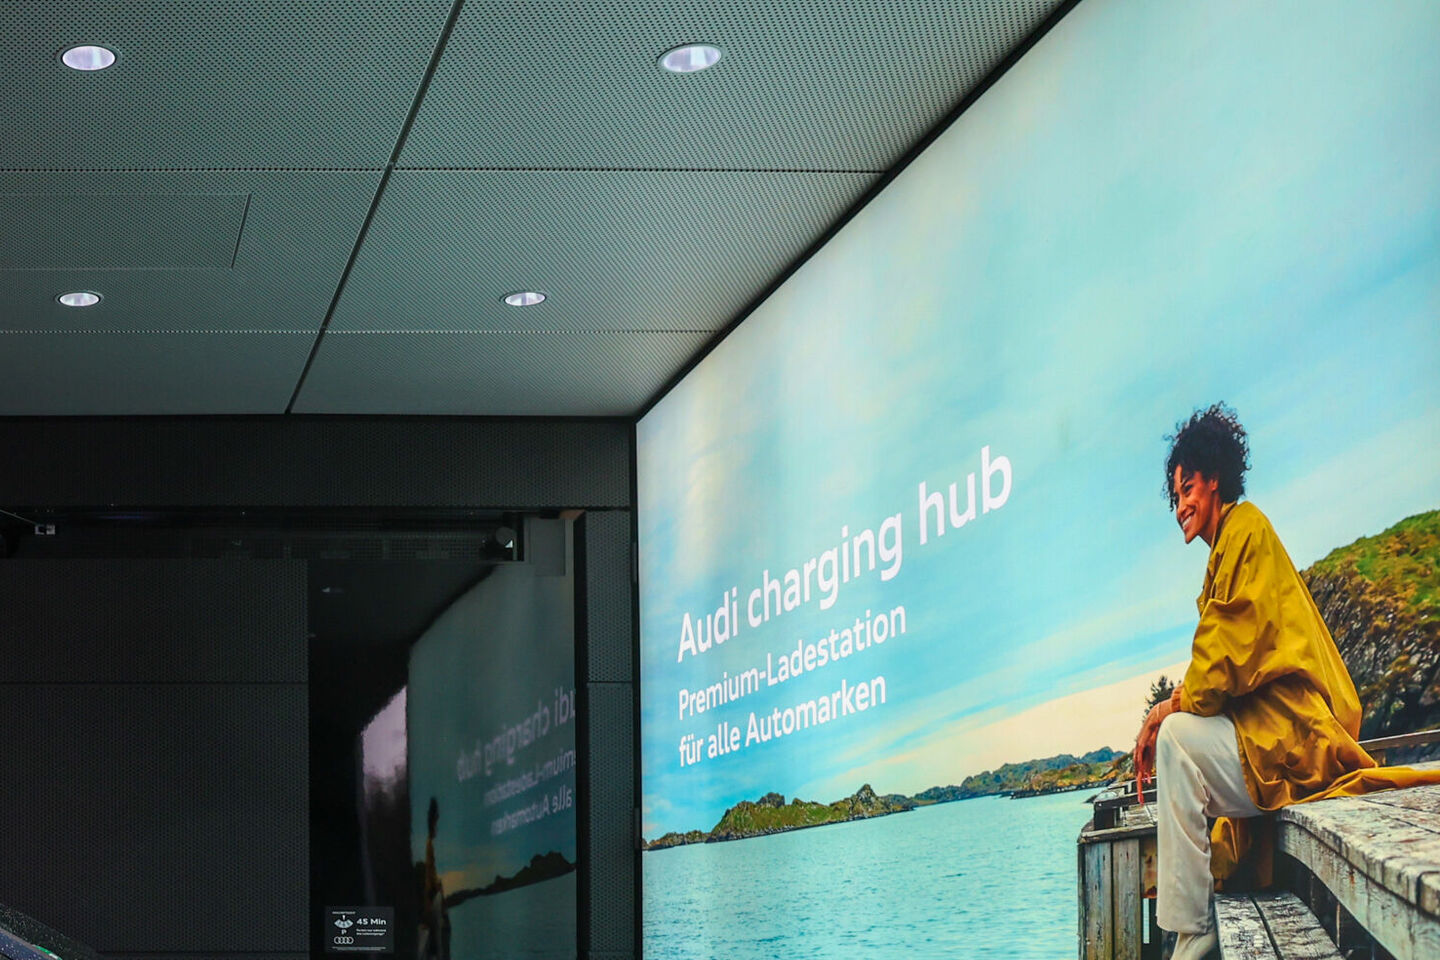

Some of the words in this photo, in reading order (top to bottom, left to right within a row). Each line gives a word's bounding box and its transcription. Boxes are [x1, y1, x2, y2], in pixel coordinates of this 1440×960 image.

[677, 586, 738, 663] Audi
[747, 513, 903, 628] charging
[918, 445, 1013, 546] hub
[678, 605, 907, 721] Premium-Ladestation
[678, 733, 705, 768] für
[707, 721, 741, 759] alle
[744, 675, 887, 748] Automarken
